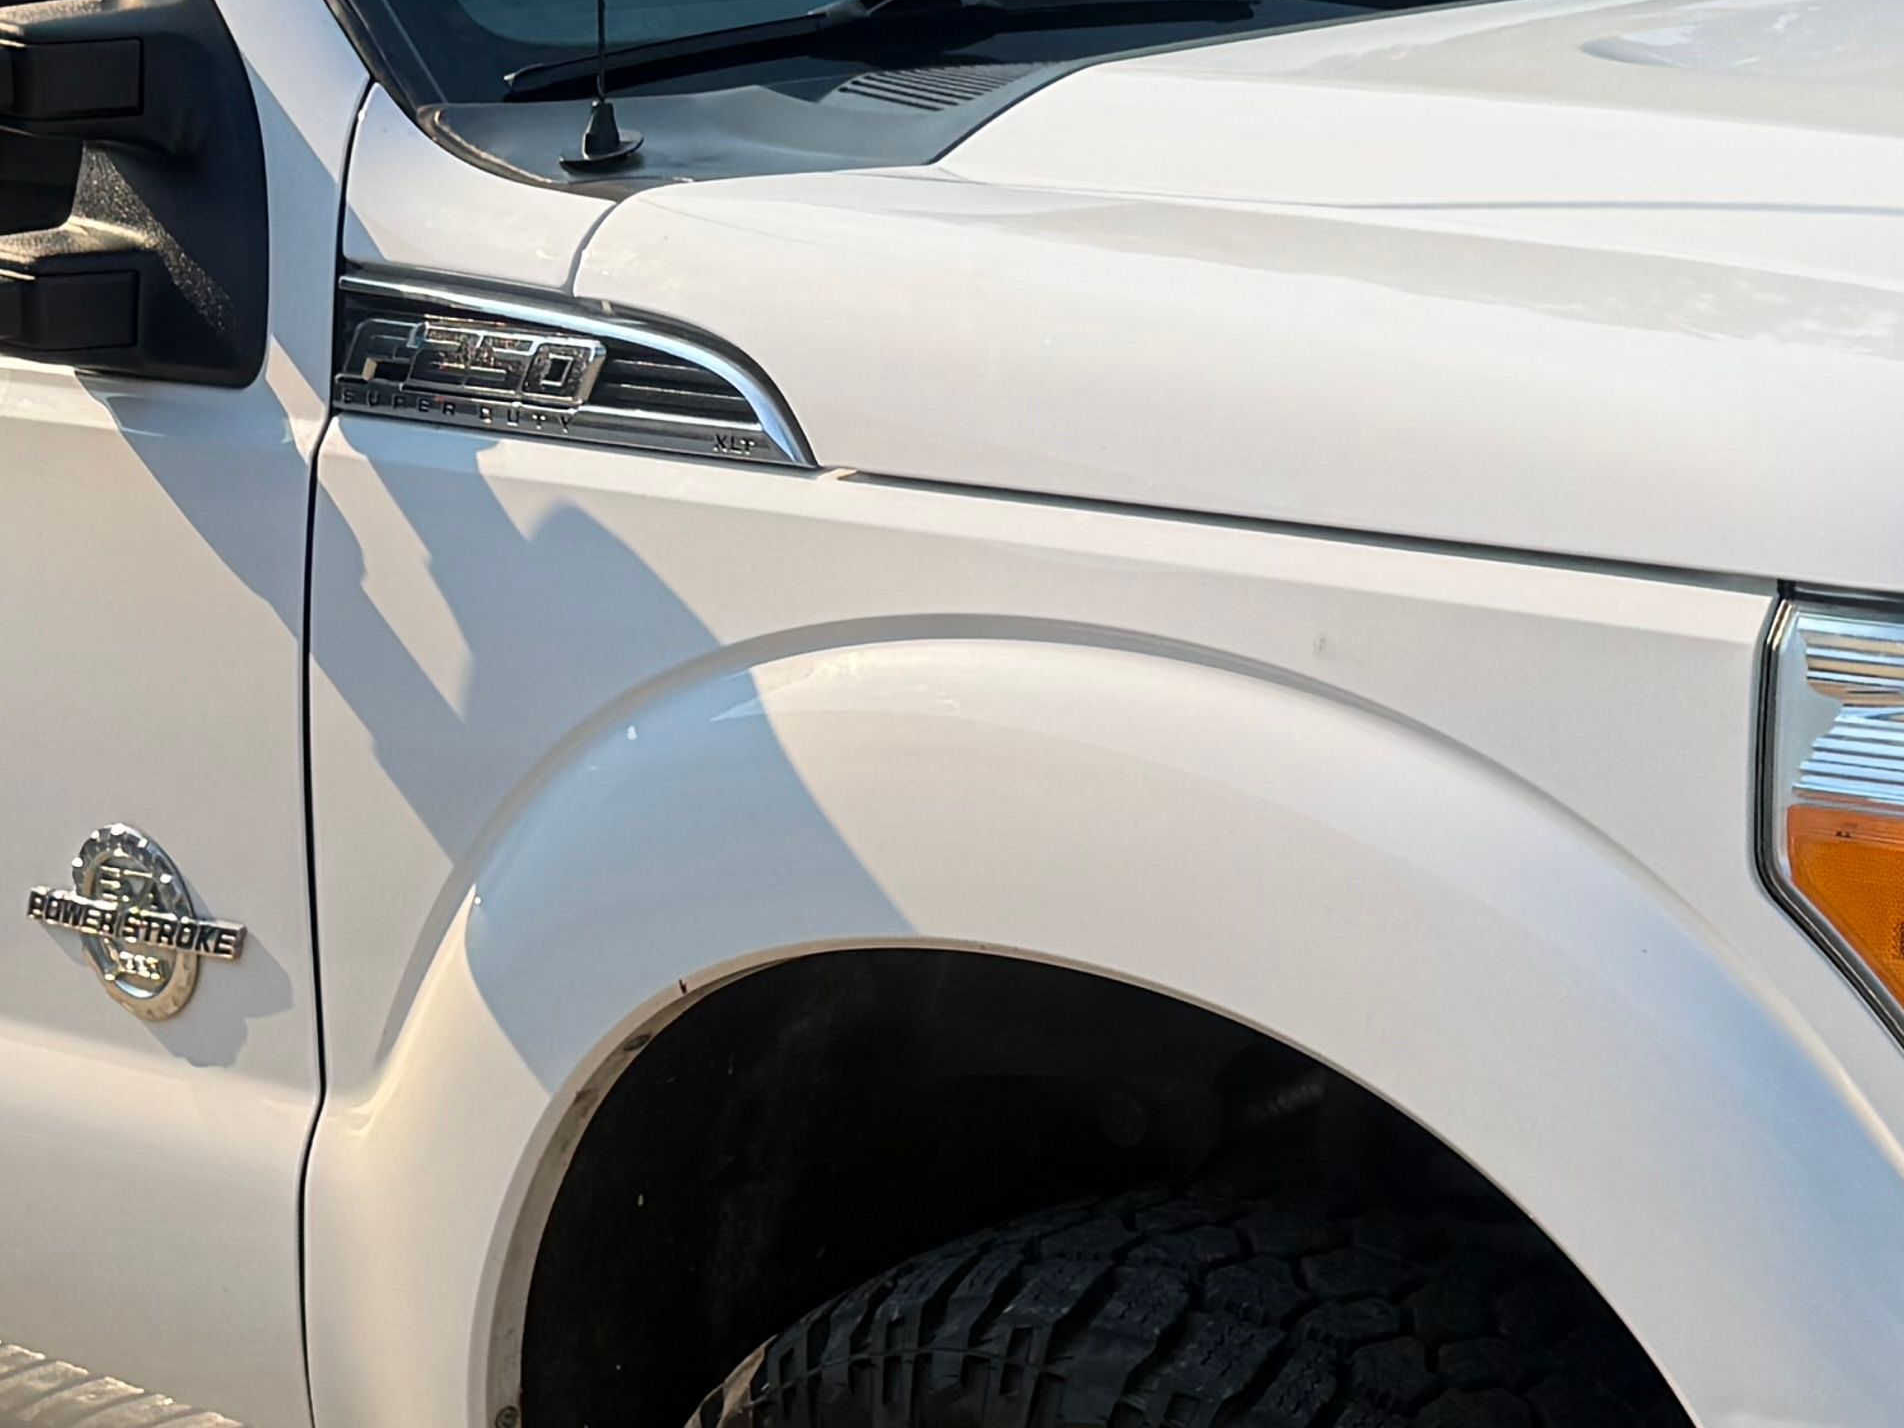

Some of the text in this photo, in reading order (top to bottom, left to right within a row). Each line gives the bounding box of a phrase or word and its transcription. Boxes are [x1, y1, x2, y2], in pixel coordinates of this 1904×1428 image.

[342, 391, 573, 434] SUPER DUTY
[712, 433, 756, 456] XLT
[28, 889, 240, 958] POWER STROKE
